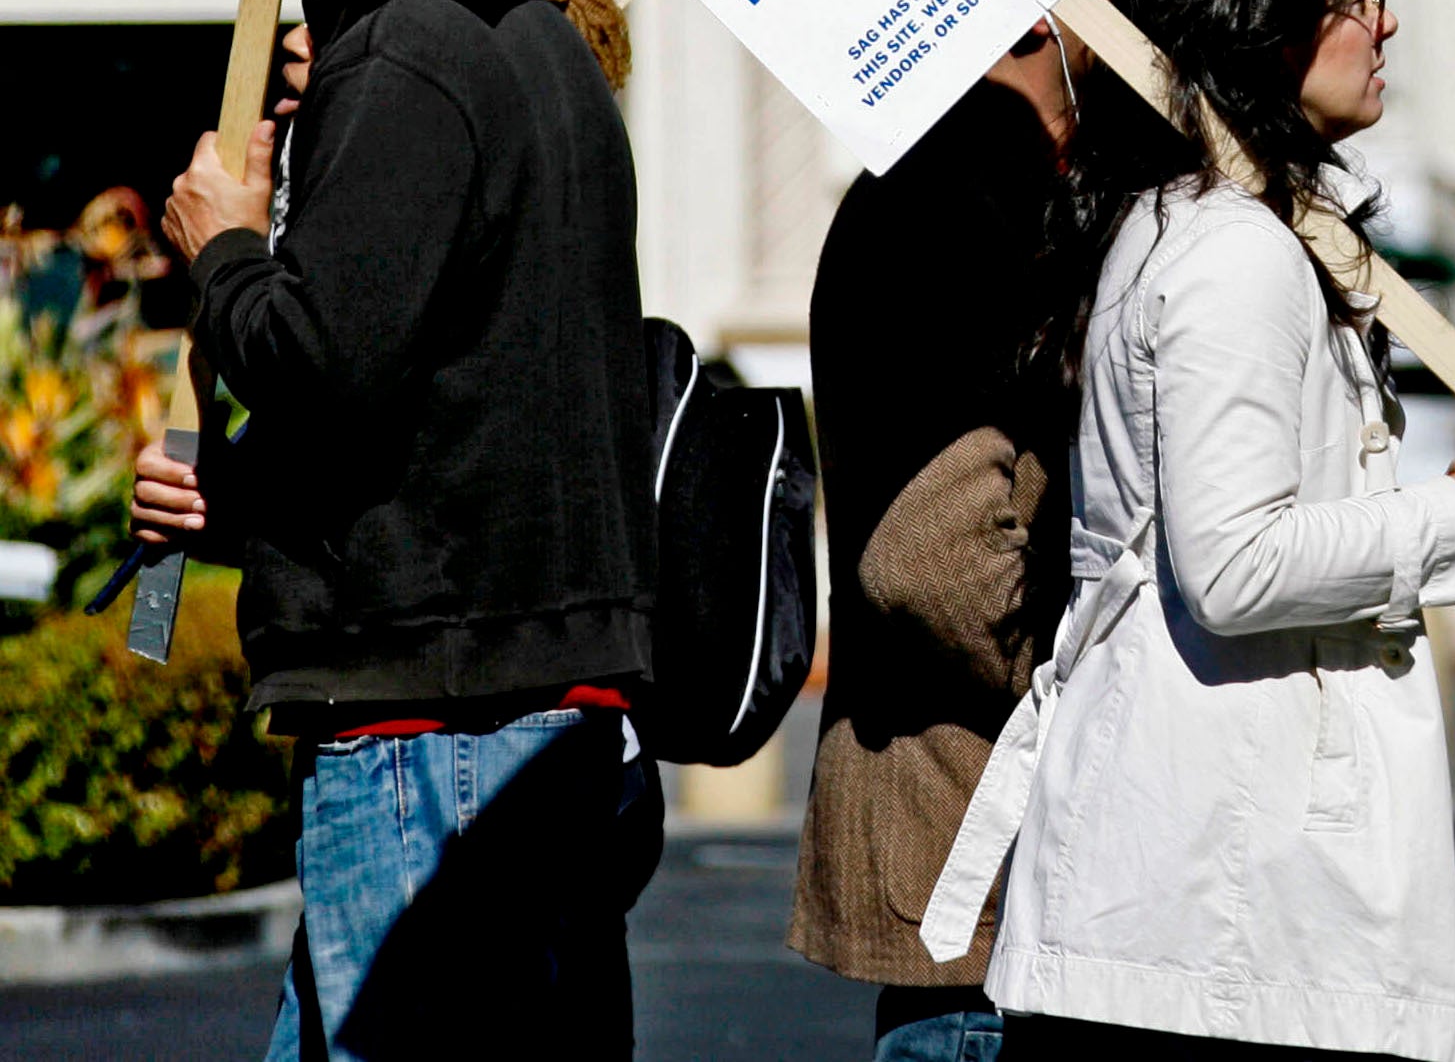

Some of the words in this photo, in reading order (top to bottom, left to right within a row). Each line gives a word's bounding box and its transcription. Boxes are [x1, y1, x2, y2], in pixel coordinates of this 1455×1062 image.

[847, 29, 881, 60] SAG
[878, 0, 911, 31] HAS
[853, 51, 889, 84] THIS
[886, 19, 925, 54] SITE.
[861, 40, 938, 107] VENDORS,
[934, 13, 959, 38] OR
